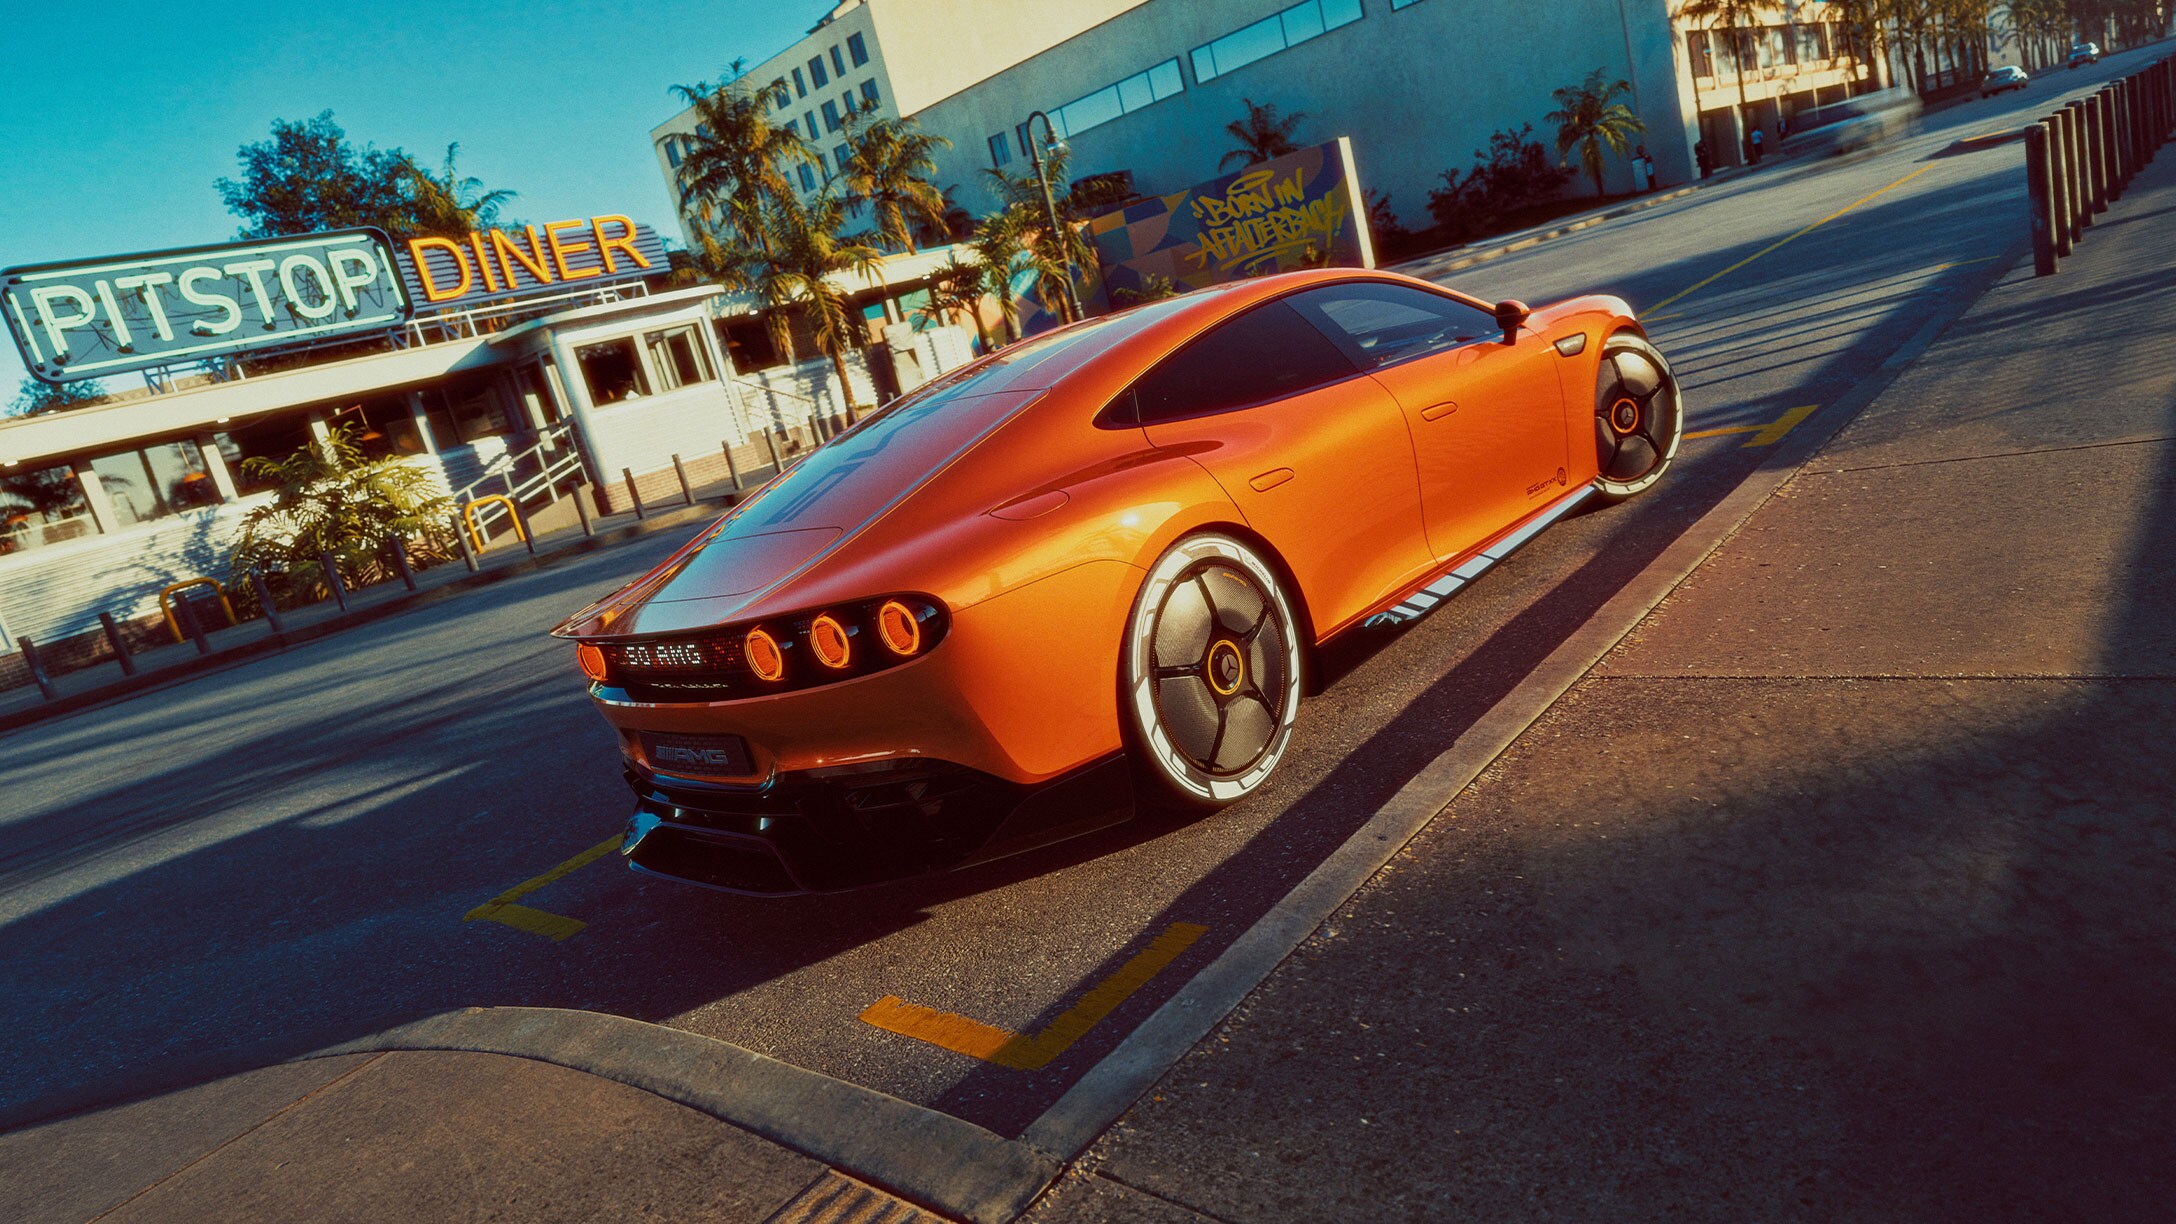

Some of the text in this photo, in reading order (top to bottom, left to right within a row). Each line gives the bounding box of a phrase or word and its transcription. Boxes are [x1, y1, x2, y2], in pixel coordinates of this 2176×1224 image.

[1198, 167, 1305, 226] BORN IN
[30, 212, 652, 358] PITSTOP DINER
[656, 644, 701, 665] AMG
